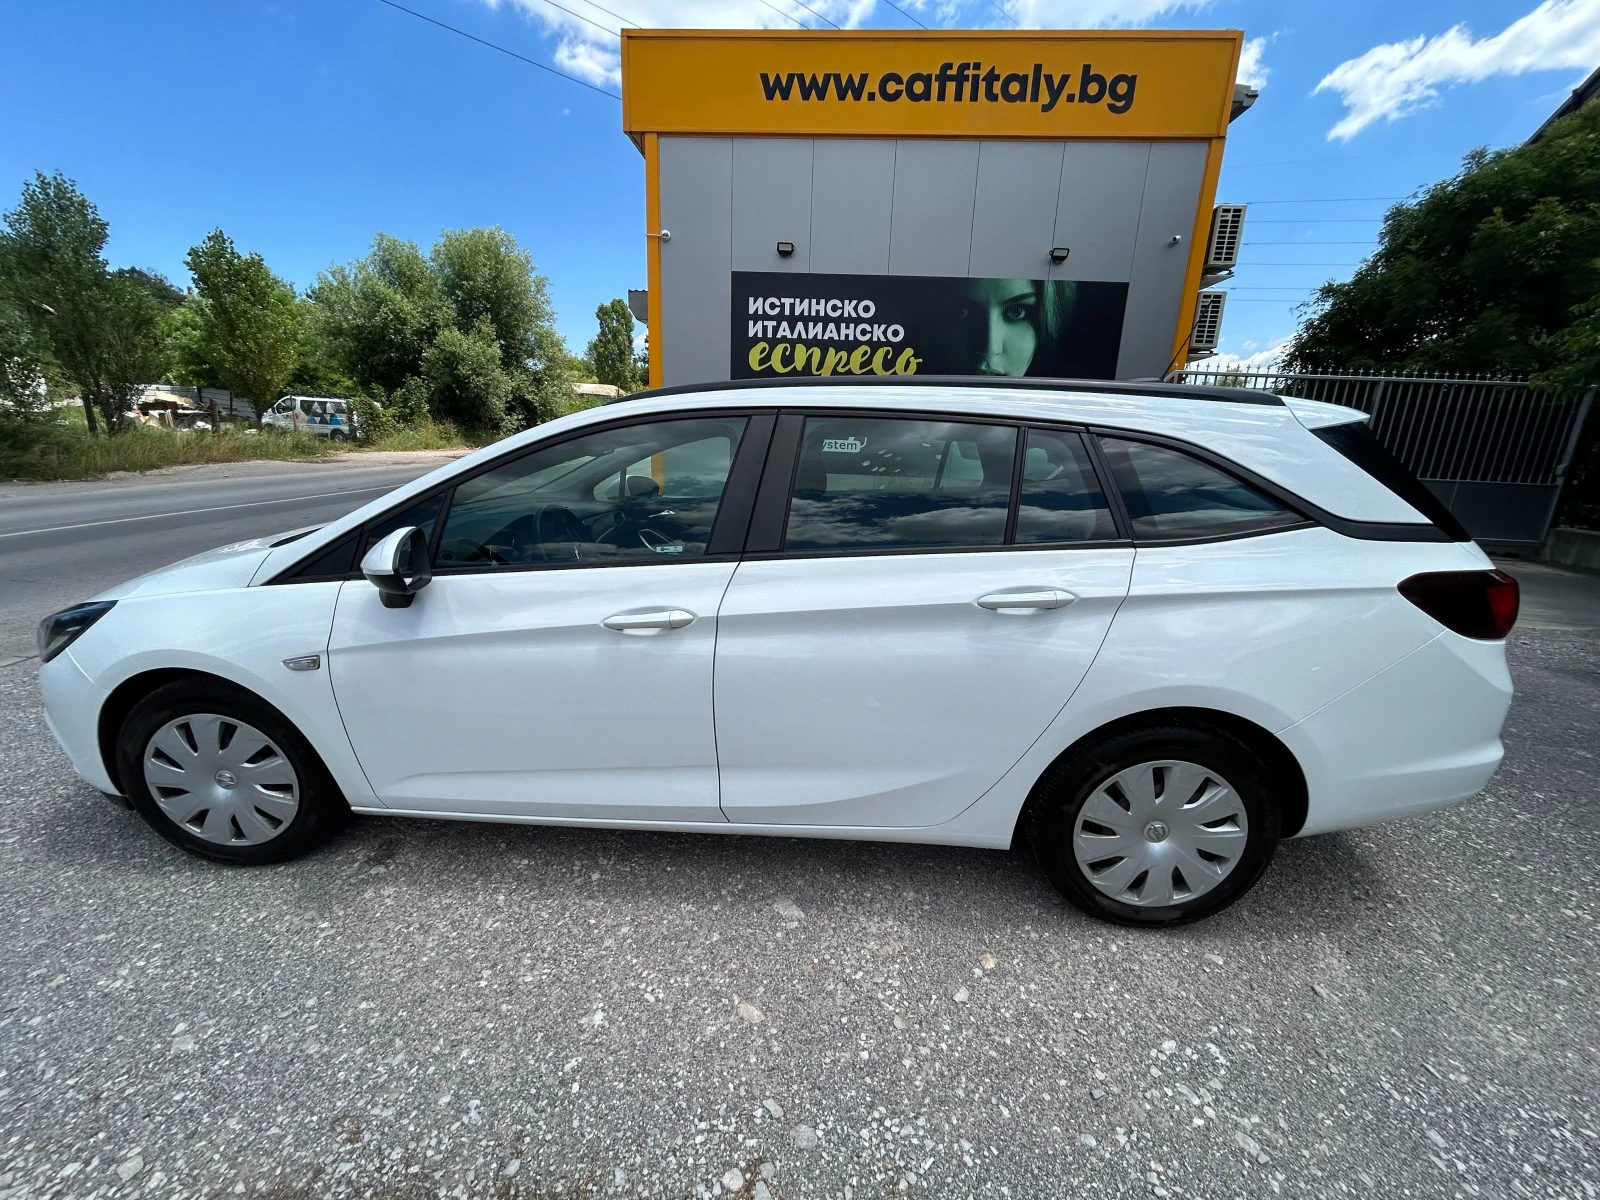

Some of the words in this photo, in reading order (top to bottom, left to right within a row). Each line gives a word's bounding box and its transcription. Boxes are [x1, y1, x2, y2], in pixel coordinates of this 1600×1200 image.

[759, 62, 1138, 114] www.caffitaly.bg
[748, 296, 876, 319] ИСТИНСКО
[748, 320, 905, 342] ИТАЛИАНСКО
